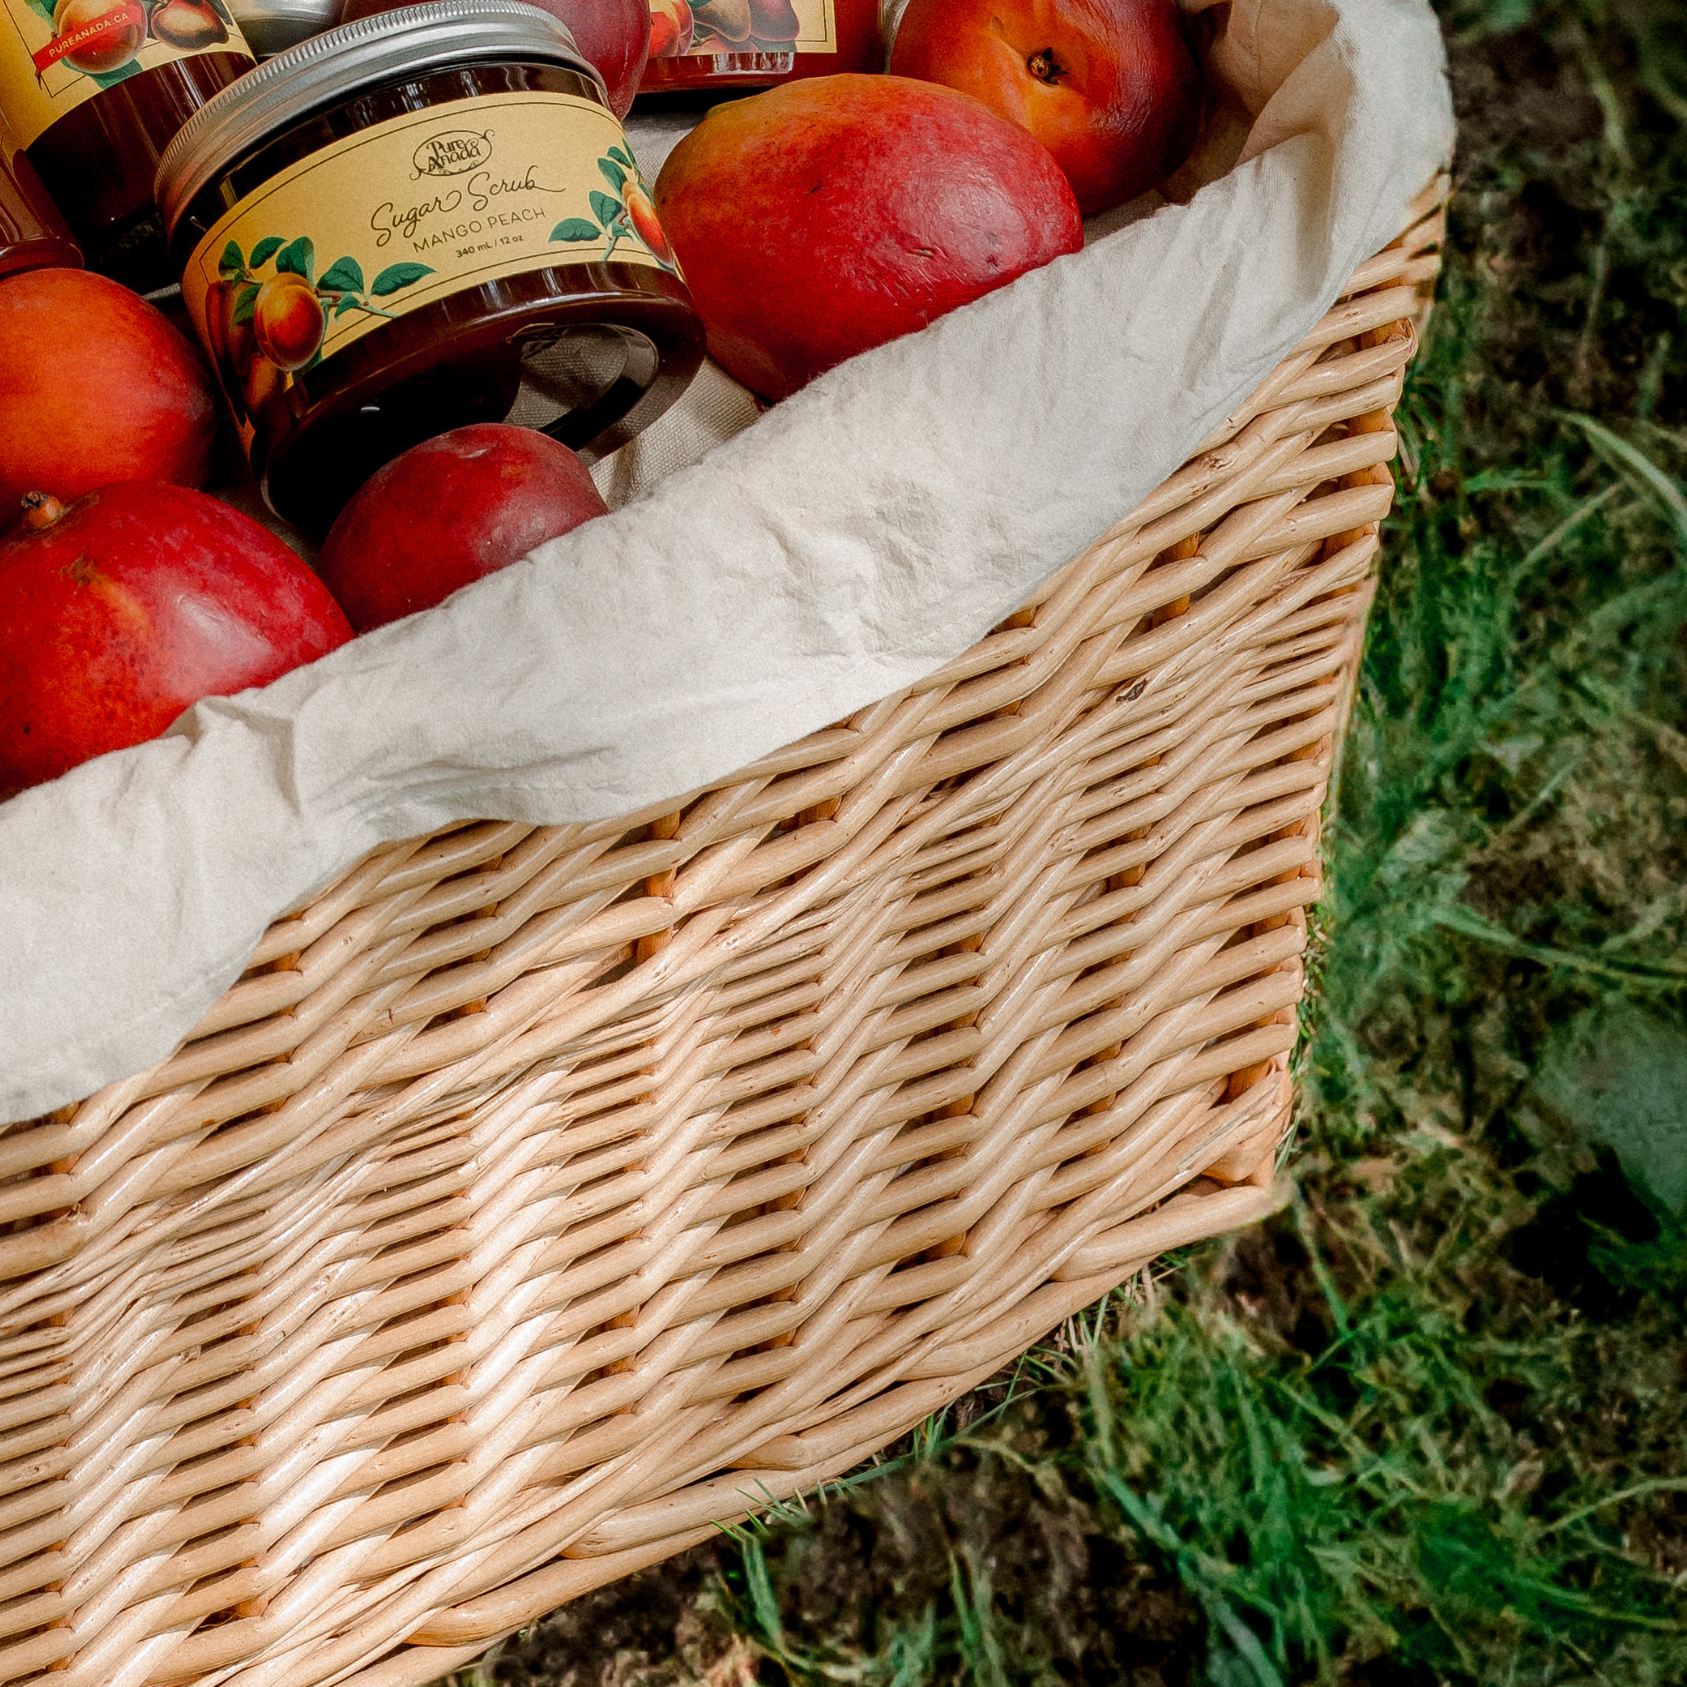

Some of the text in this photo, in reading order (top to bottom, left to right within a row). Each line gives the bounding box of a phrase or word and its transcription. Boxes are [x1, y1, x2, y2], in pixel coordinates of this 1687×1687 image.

[48, 12, 129, 57] PUREANADA.CA
[426, 139, 467, 159] Pure
[427, 141, 481, 173] Anada
[370, 165, 566, 247] Sugar Scrub
[413, 207, 546, 254] MANGO PEACH
[455, 246, 476, 258] 340
[477, 241, 493, 252] mL
[499, 237, 511, 246] 12
[512, 234, 524, 243] oz
